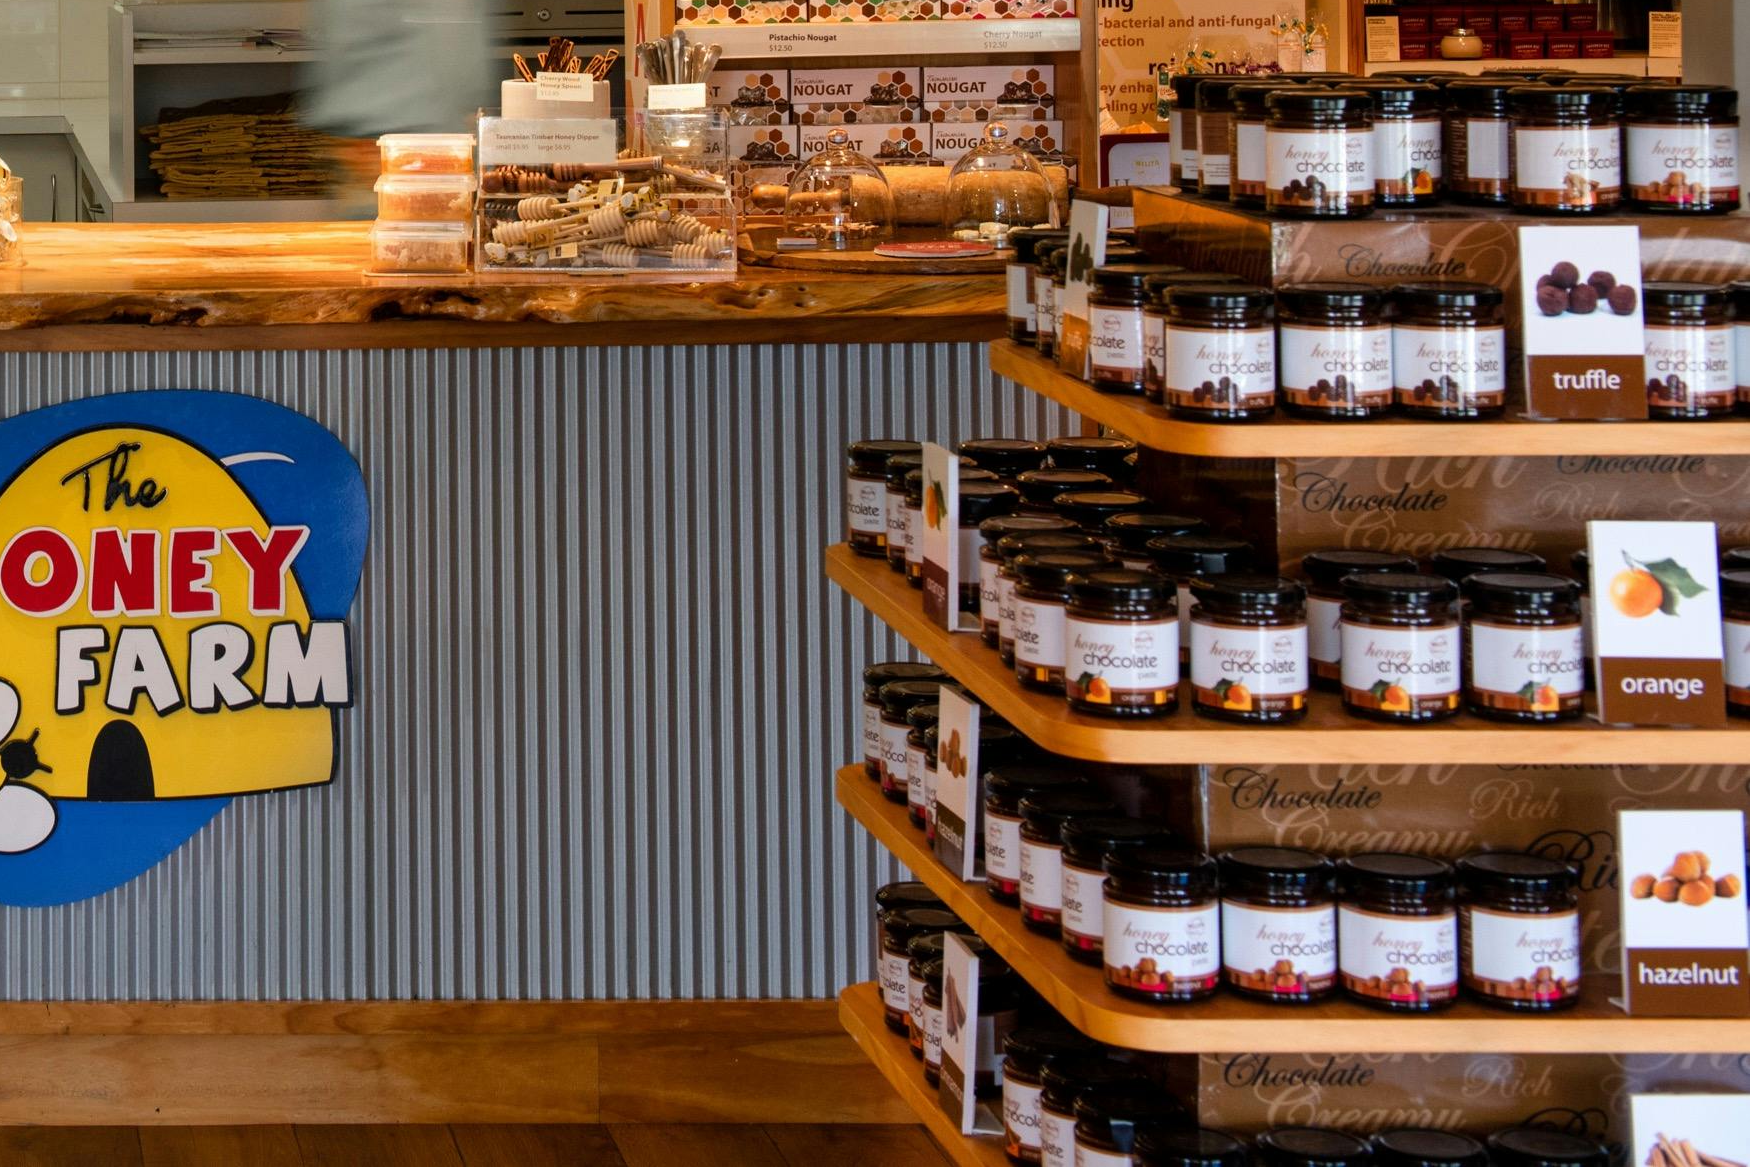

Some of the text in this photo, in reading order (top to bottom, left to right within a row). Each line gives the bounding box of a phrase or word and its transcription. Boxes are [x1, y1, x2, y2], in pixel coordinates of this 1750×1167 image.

[1099, 14, 1276, 30] -bacterial and anti-fungal
[769, 34, 837, 42] Pistachio Nougat
[984, 30, 1010, 39] Cherry
[984, 41, 1007, 49] $12.50
[794, 84, 853, 96] NOUGAT
[927, 81, 987, 94] NOUGAT
[935, 137, 986, 150] NOUGA
[1296, 160, 1365, 174] chocolate
[1338, 242, 1466, 277] Chocolate
[1209, 360, 1272, 375] chocolate
[1323, 358, 1389, 372] chocolate
[1552, 369, 1621, 390] truffle
[62, 441, 166, 513] The
[1294, 472, 1449, 514] Chocolate
[1531, 481, 1620, 522] Rich
[1074, 634, 1116, 654] honey
[1210, 640, 1256, 660] honey
[1364, 643, 1412, 665] honey
[56, 621, 355, 716] FARM
[1083, 653, 1158, 668] chocolate
[1221, 658, 1296, 674] chocolate
[1378, 659, 1451, 674] chocolate
[1621, 675, 1703, 697] orange
[1223, 766, 1382, 810] Chocolate
[1469, 777, 1563, 821] Rich
[1123, 921, 1170, 944] honey
[1135, 940, 1209, 956] chocolate
[1639, 962, 1739, 985] hazelnut
[1461, 1058, 1553, 1099] Rich
